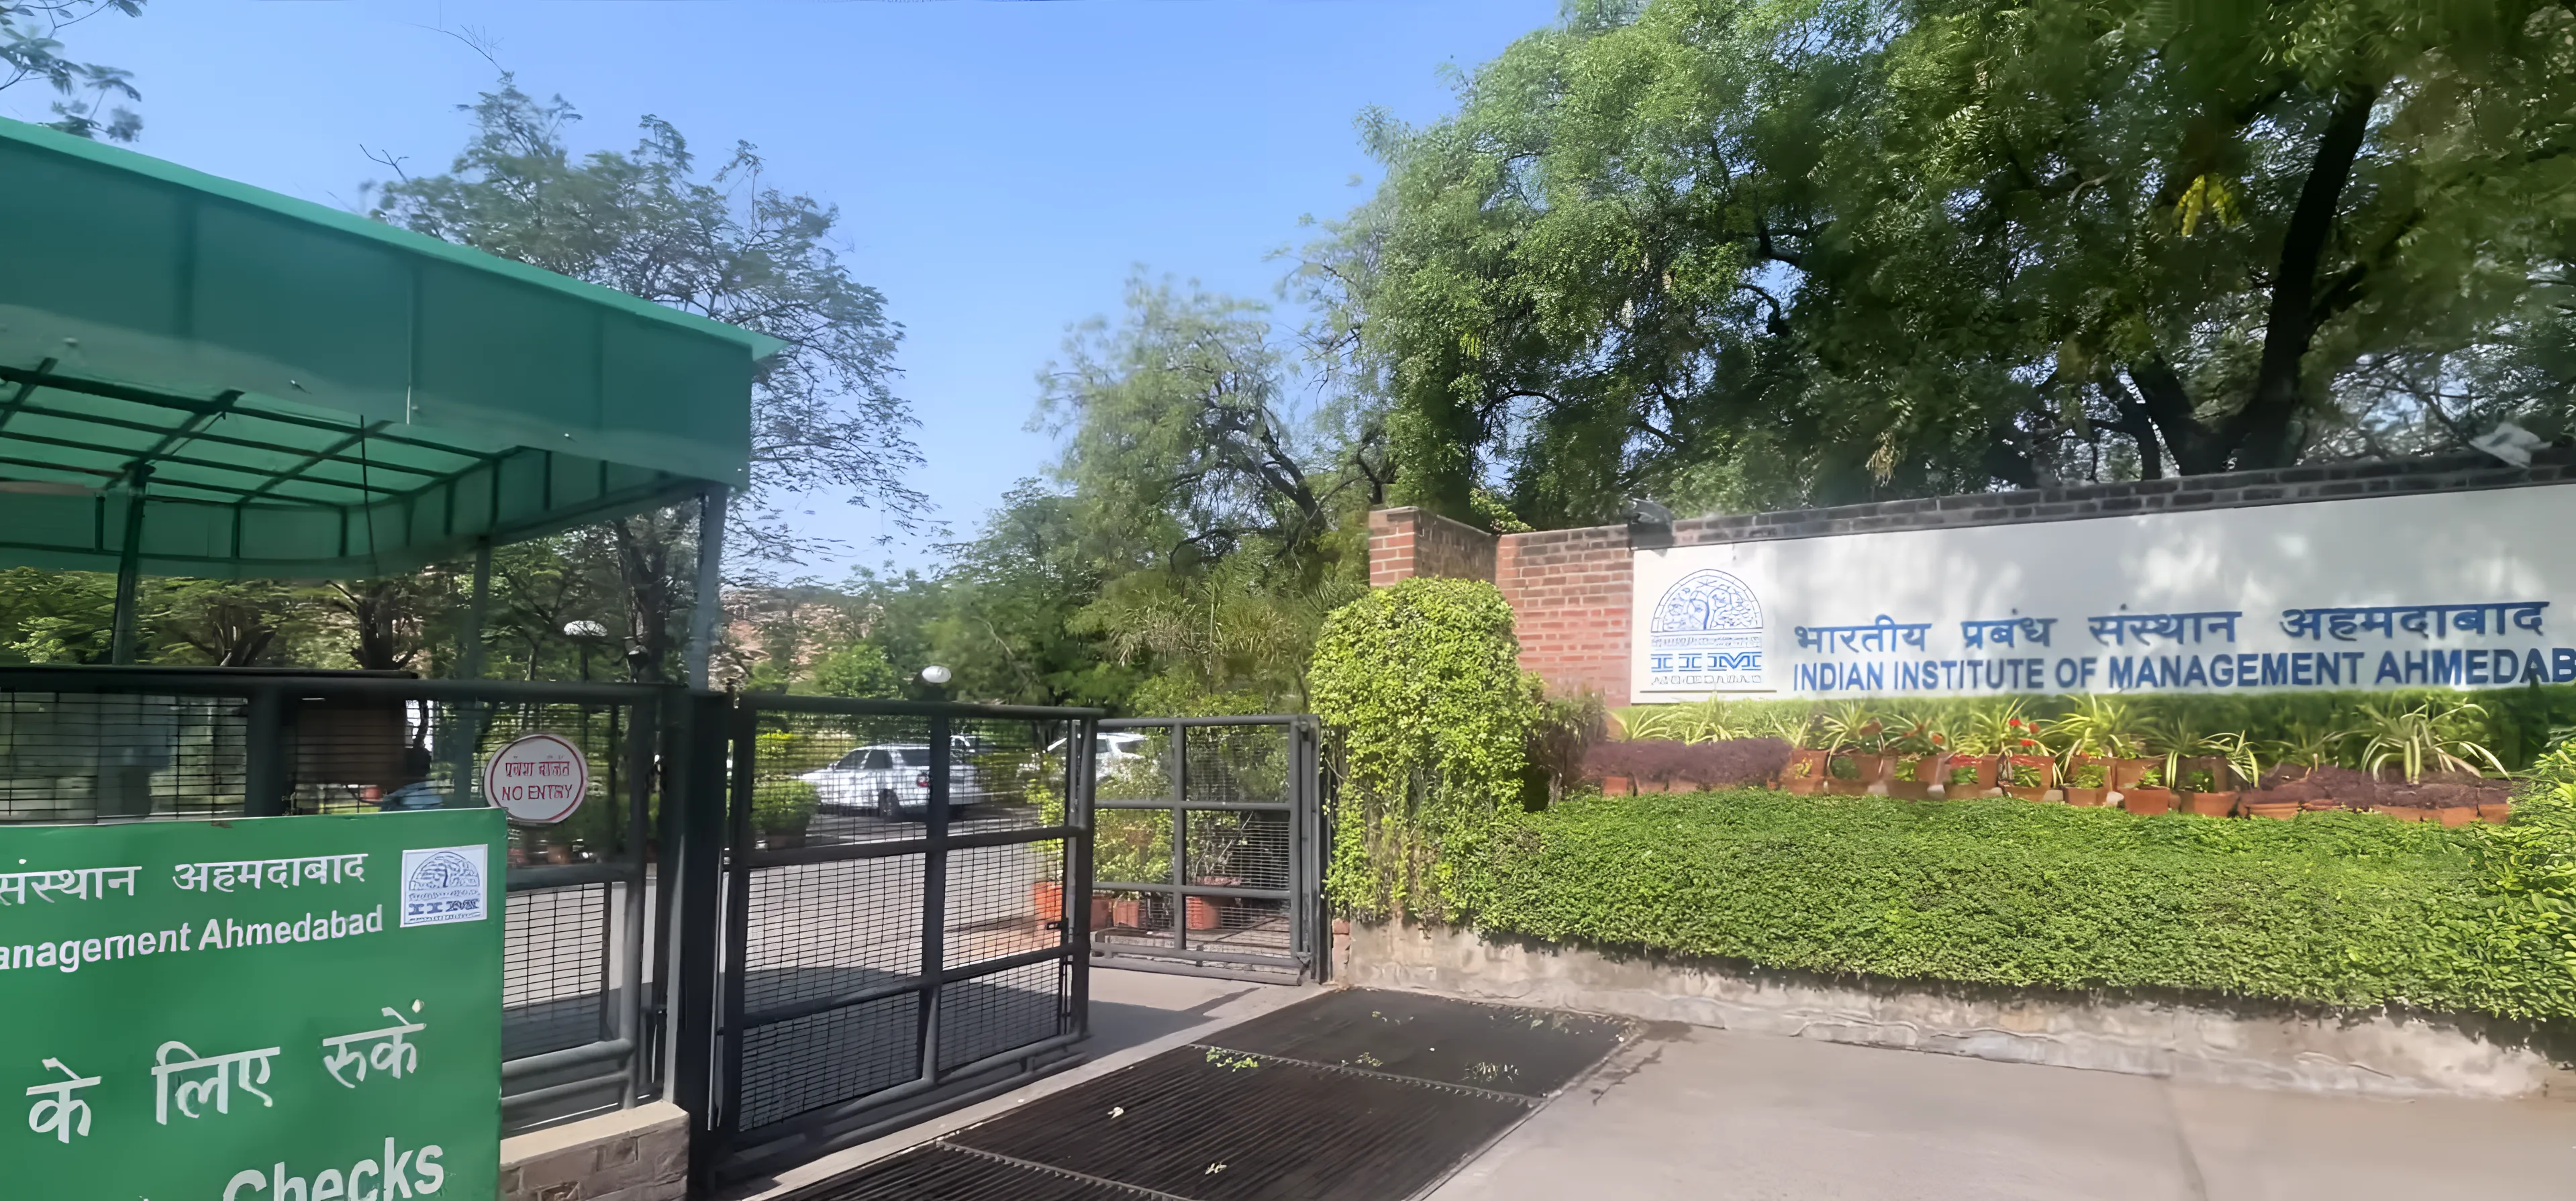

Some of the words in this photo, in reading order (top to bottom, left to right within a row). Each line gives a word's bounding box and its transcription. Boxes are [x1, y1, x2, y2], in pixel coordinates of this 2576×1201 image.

[1794, 614, 1932, 654] भारतीय
[1961, 608, 2057, 649] प्रबंध
[2087, 603, 2242, 647] संस्थान
[2280, 601, 2550, 641] अहमदाबाद
[1793, 662, 1884, 691] INDIAN
[1893, 658, 2044, 690] INSTITUTE
[2054, 657, 2097, 688] OF
[2109, 651, 2365, 688] MANAGEMENT
[502, 786, 523, 801] NO
[528, 784, 573, 800] ENTRY
[172, 853, 369, 893] अहमदाबाद
[198, 903, 383, 951] Ahmedabad
[26, 1057, 102, 1144] के
[150, 1040, 281, 1126] लिए
[321, 998, 428, 1089] रुकें
[222, 1137, 444, 1201] Checks
